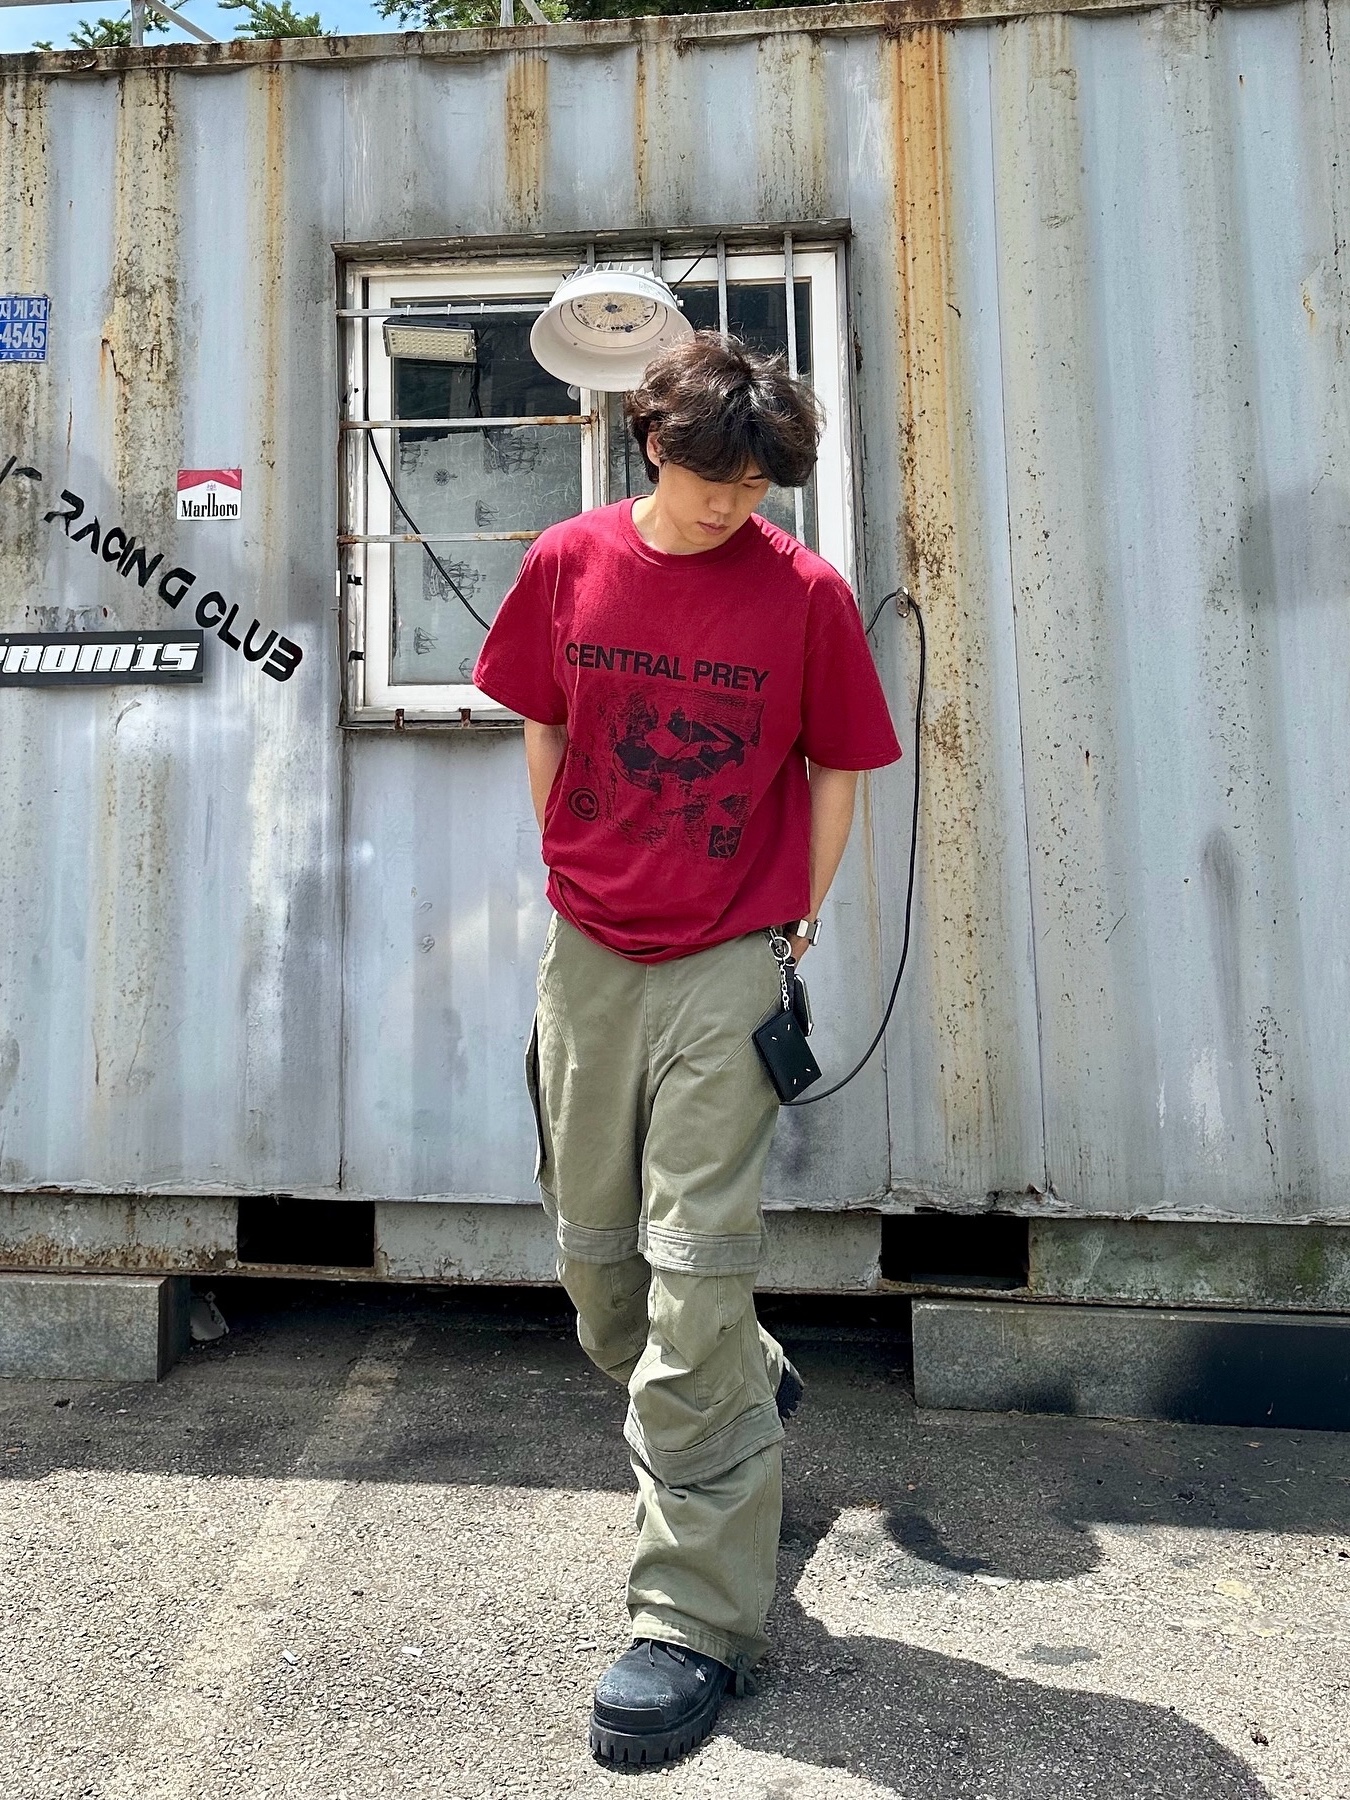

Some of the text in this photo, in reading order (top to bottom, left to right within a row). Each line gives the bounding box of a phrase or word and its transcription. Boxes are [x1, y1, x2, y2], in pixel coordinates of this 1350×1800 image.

[181, 493, 238, 517] Marlboro
[43, 489, 304, 682] RACING CLUB
[0, 643, 200, 673] ROMIS
[565, 642, 770, 692] CENTRAL PREY
